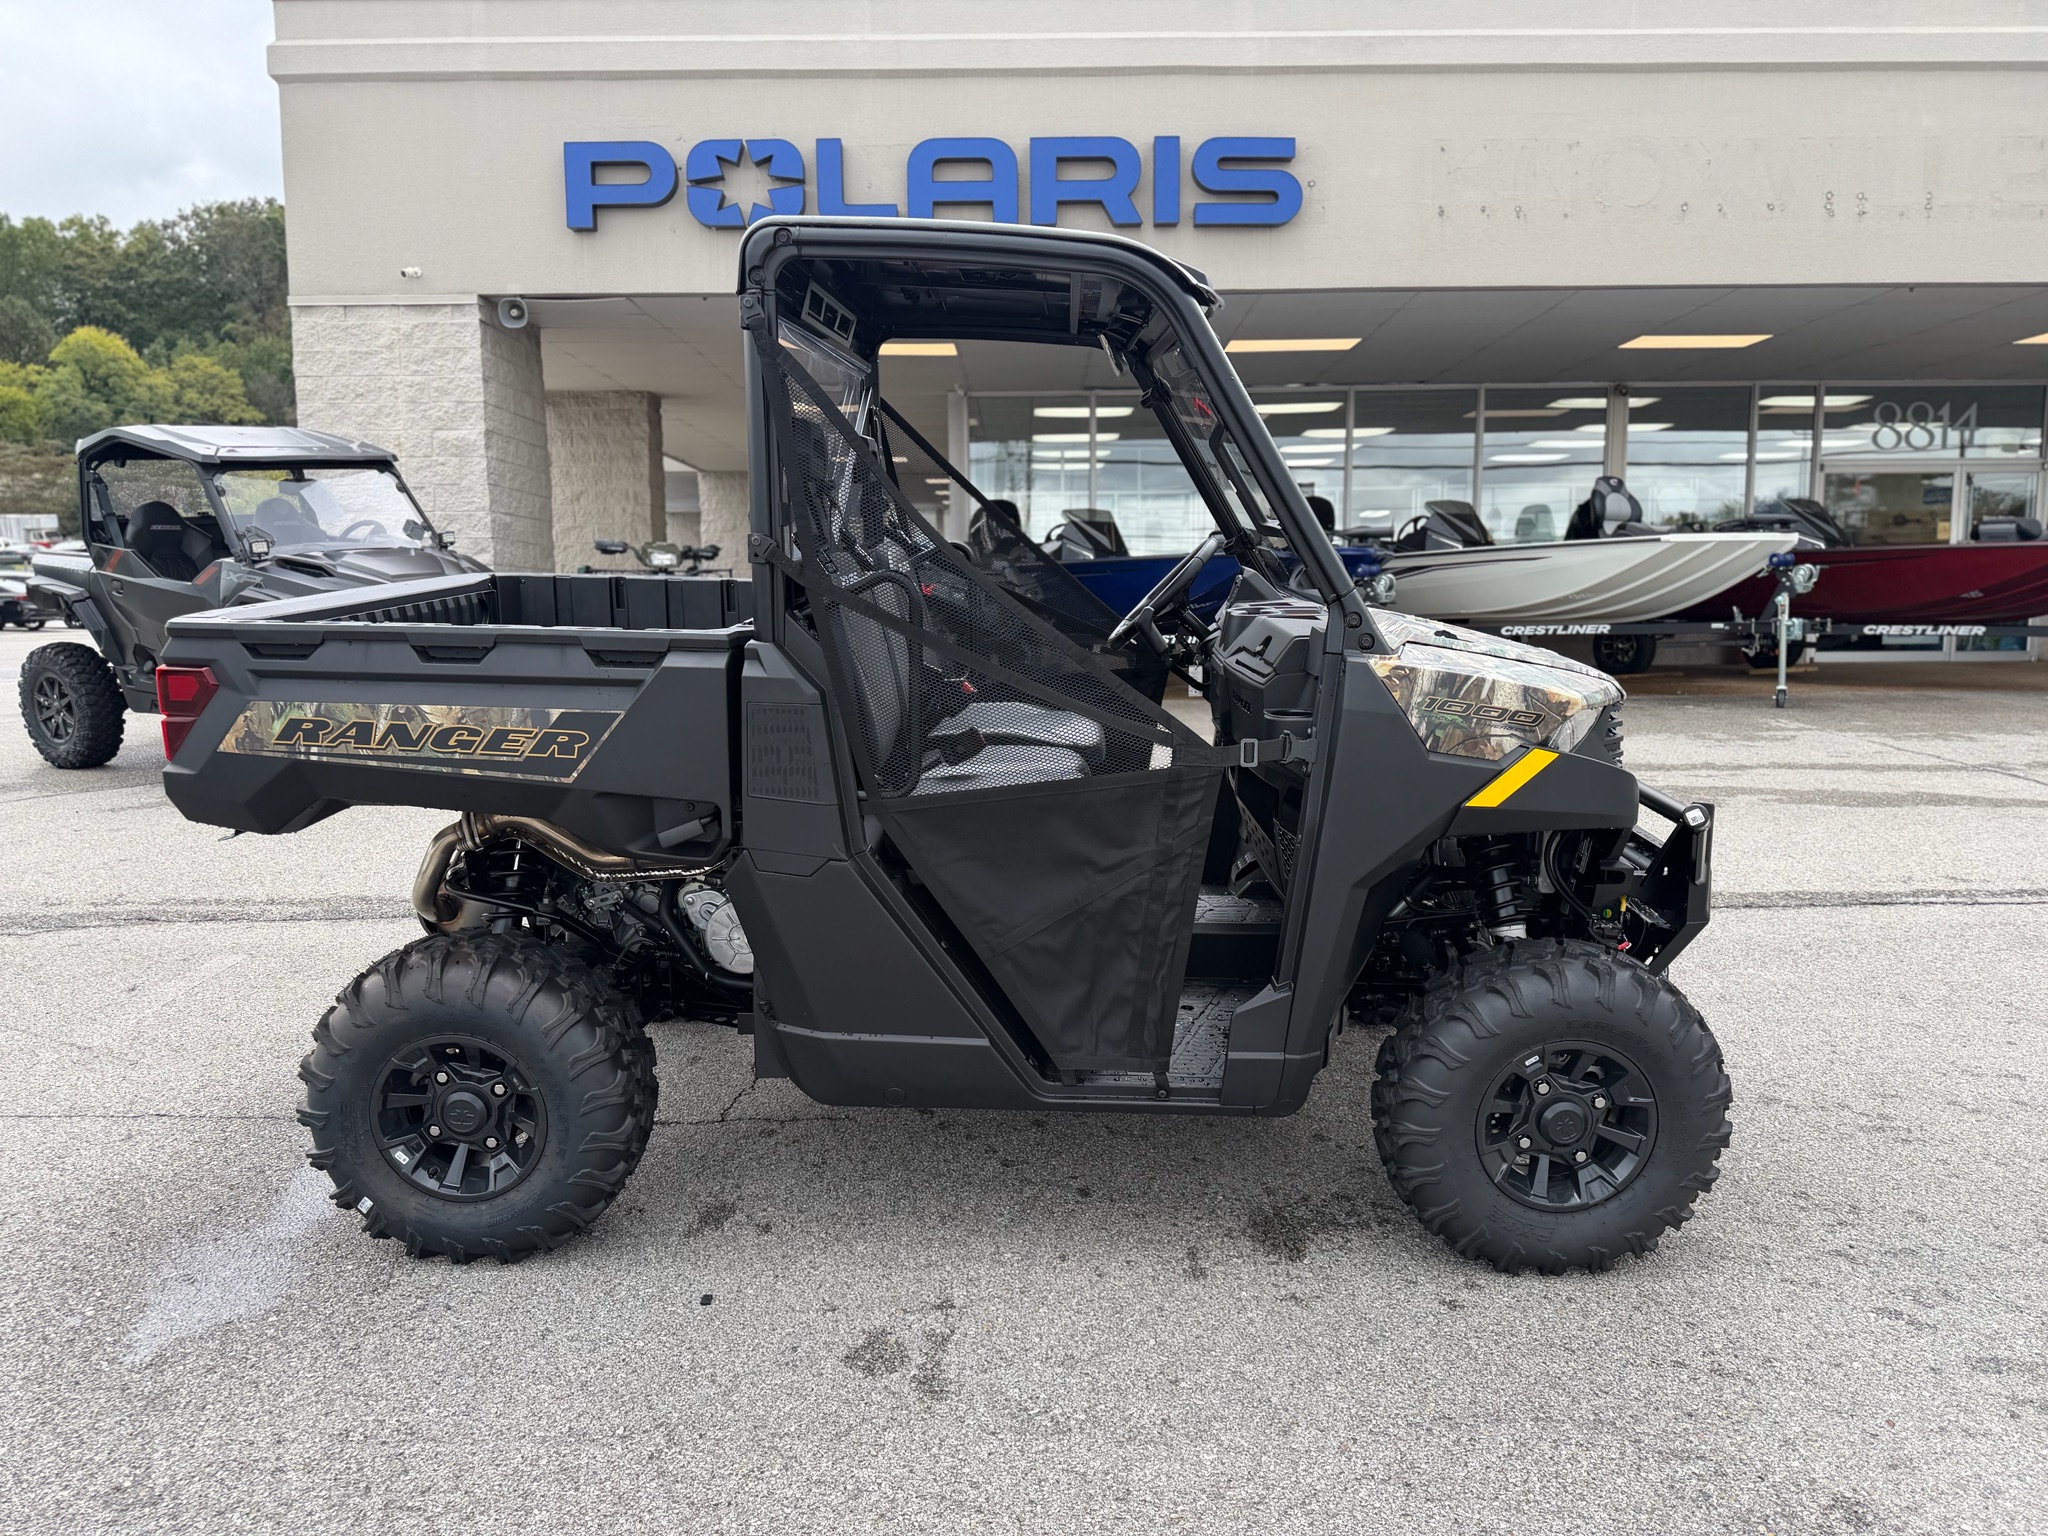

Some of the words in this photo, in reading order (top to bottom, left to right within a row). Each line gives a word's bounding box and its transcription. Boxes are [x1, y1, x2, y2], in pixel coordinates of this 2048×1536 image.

[563, 135, 1304, 232] POLARIS
[1871, 401, 1980, 450] 8814
[223, 571, 264, 584] XP
[1500, 623, 1611, 636] CRESTLINER
[1863, 624, 1987, 637] CRESTLINER
[1421, 695, 1546, 728] 1000
[272, 715, 590, 759] RANGER
